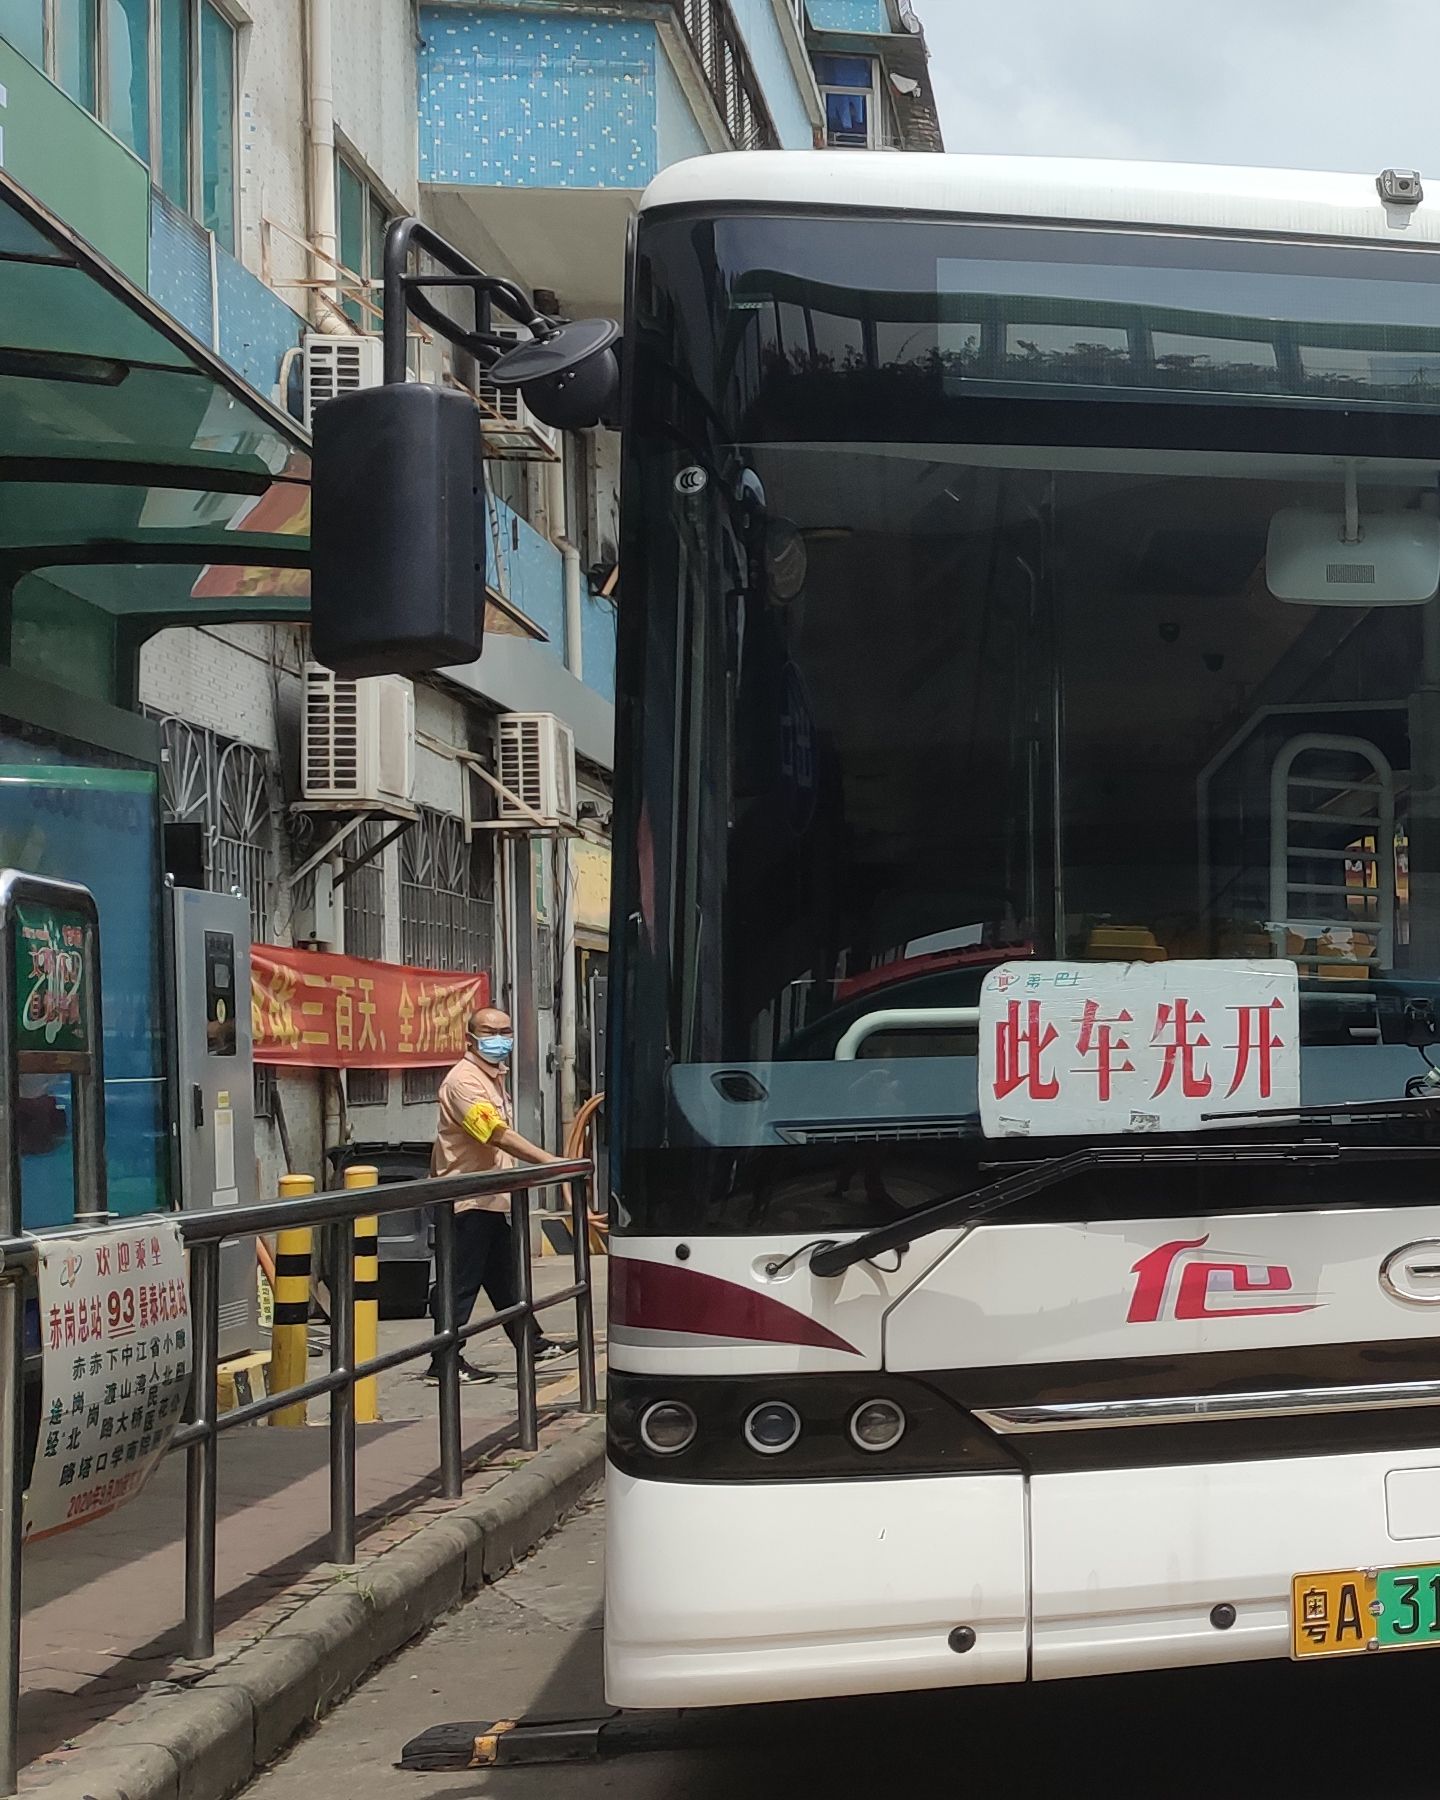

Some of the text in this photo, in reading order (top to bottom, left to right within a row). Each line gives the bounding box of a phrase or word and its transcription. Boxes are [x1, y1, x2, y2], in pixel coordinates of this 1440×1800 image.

[992, 998, 1285, 1102] 此车先开
[107, 1287, 135, 1327] 93
[1301, 1583, 1363, 1644] 粤A
